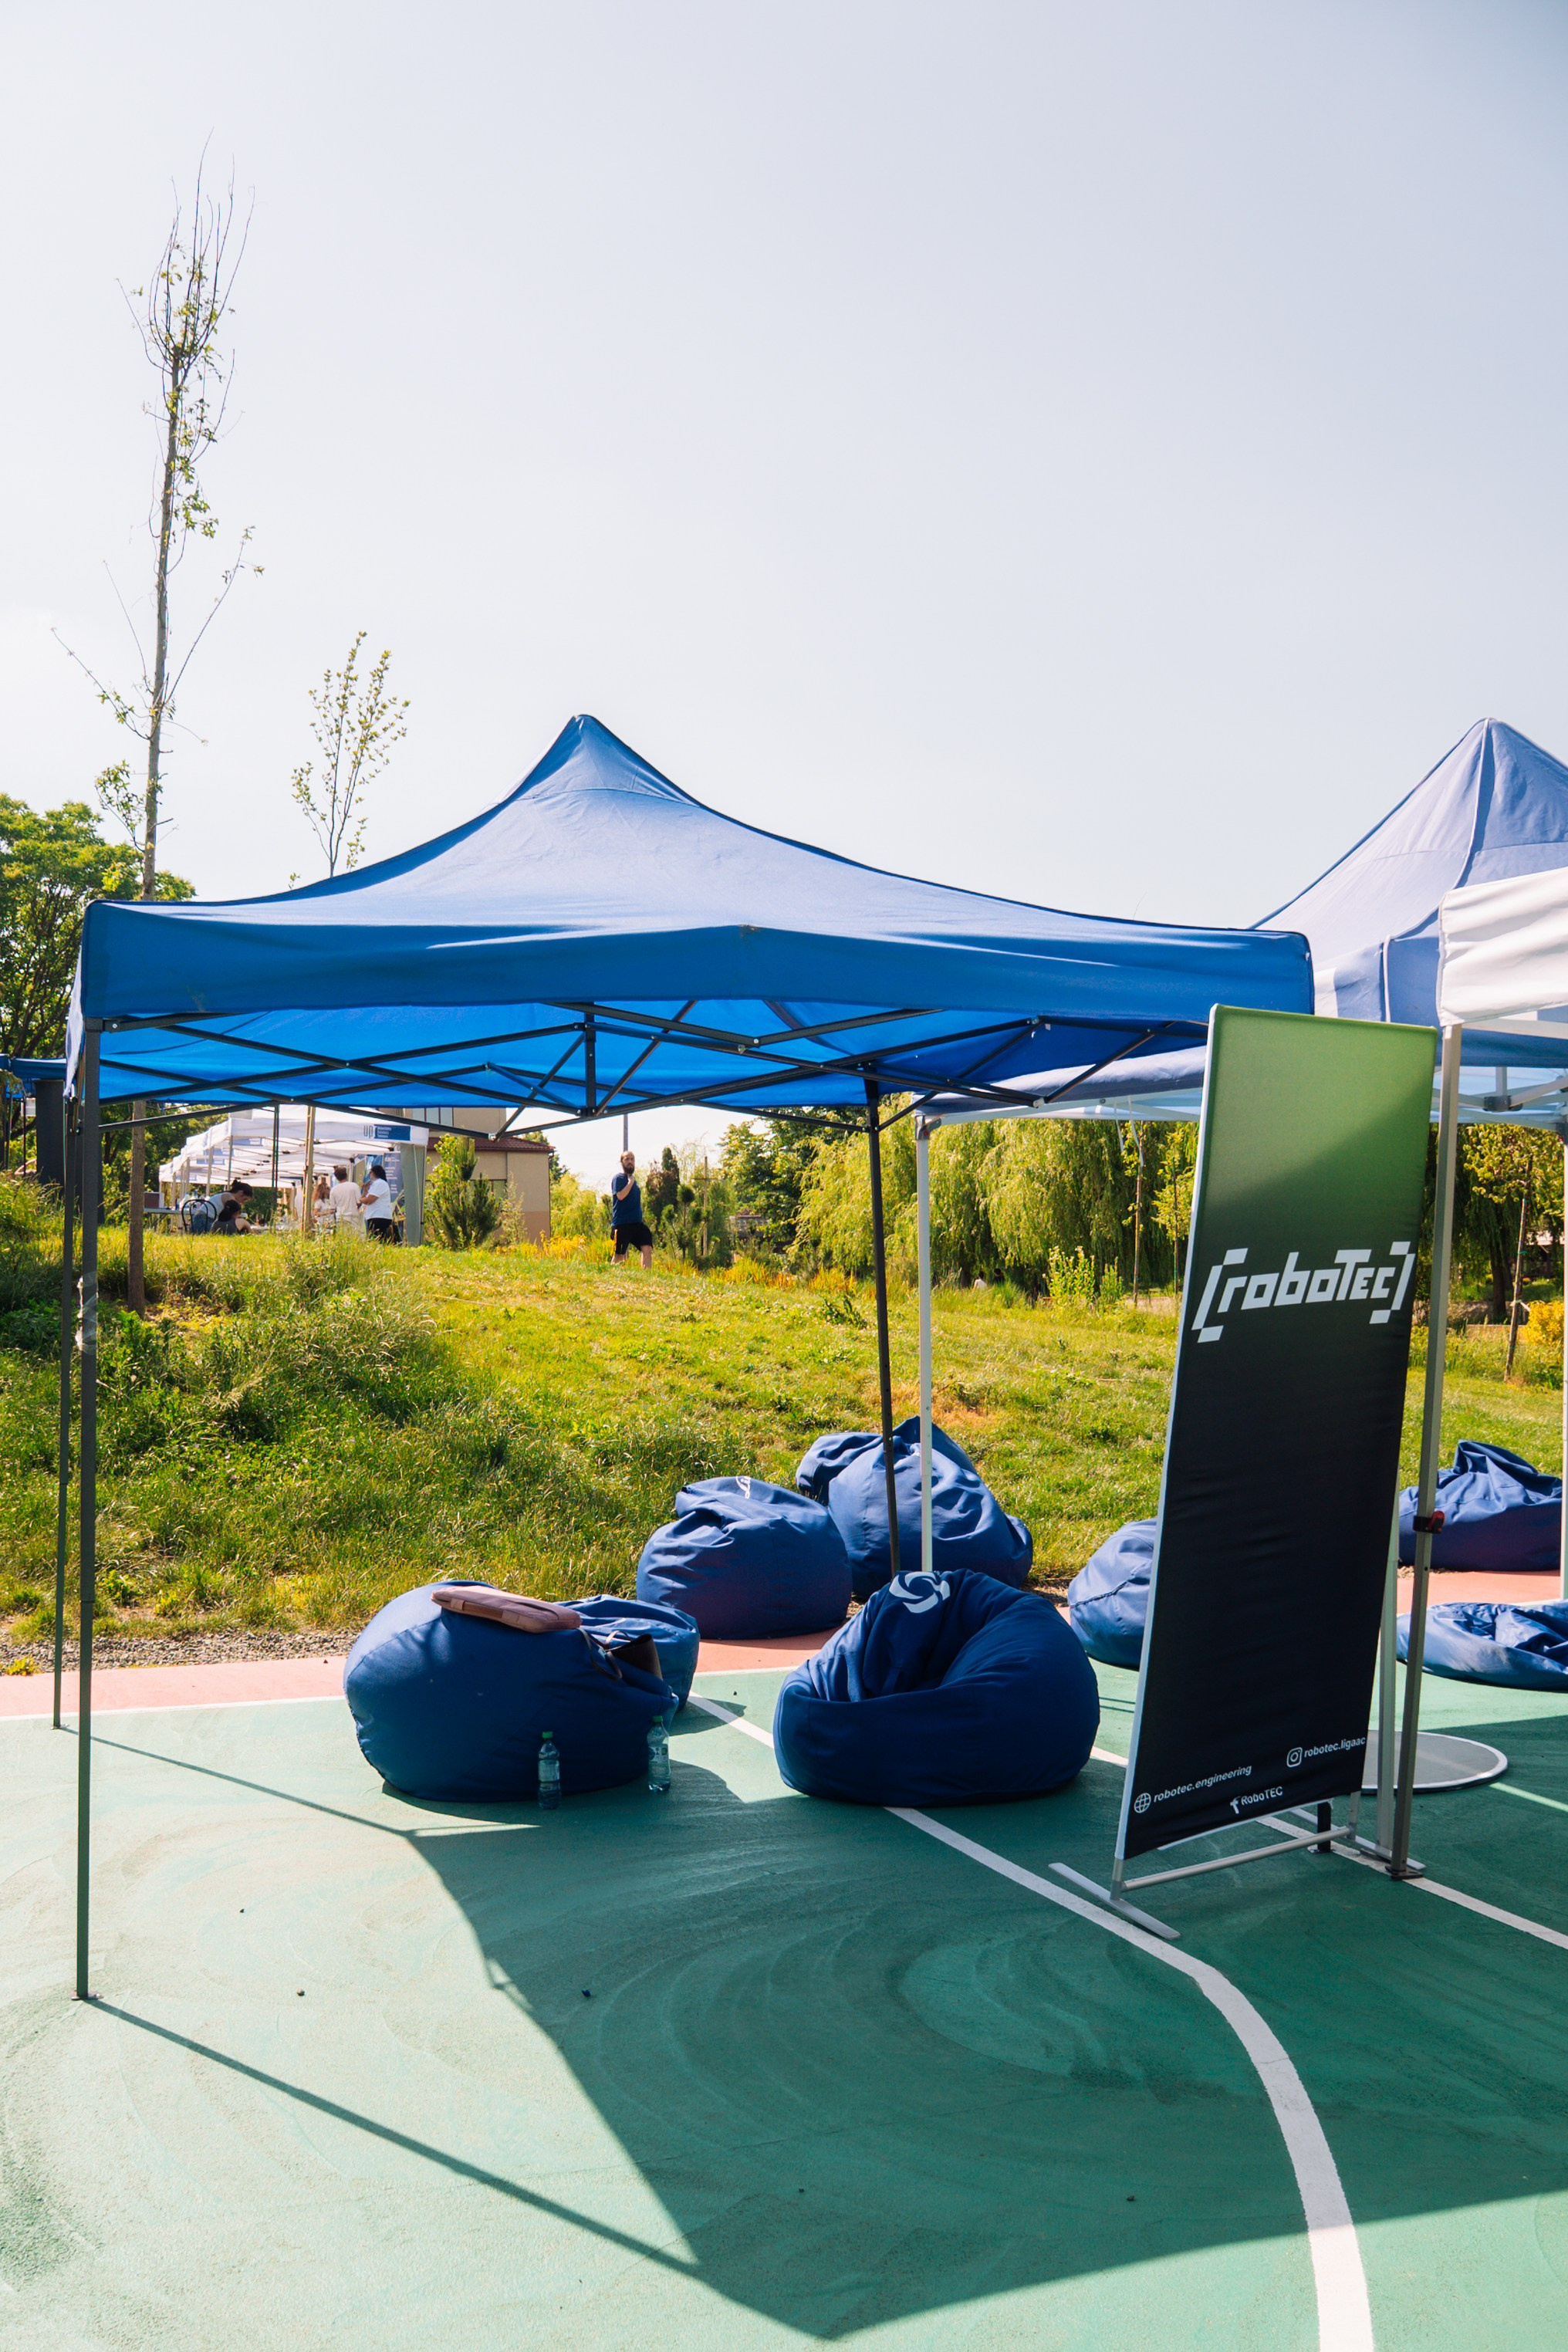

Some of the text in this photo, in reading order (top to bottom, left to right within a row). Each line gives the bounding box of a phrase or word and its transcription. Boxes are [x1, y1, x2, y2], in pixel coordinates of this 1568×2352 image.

[1304, 1737, 1366, 1758] robotec.ligaac
[1154, 1766, 1252, 1803] robotec.engineering
[1241, 1786, 1283, 1806] RoboTEC
